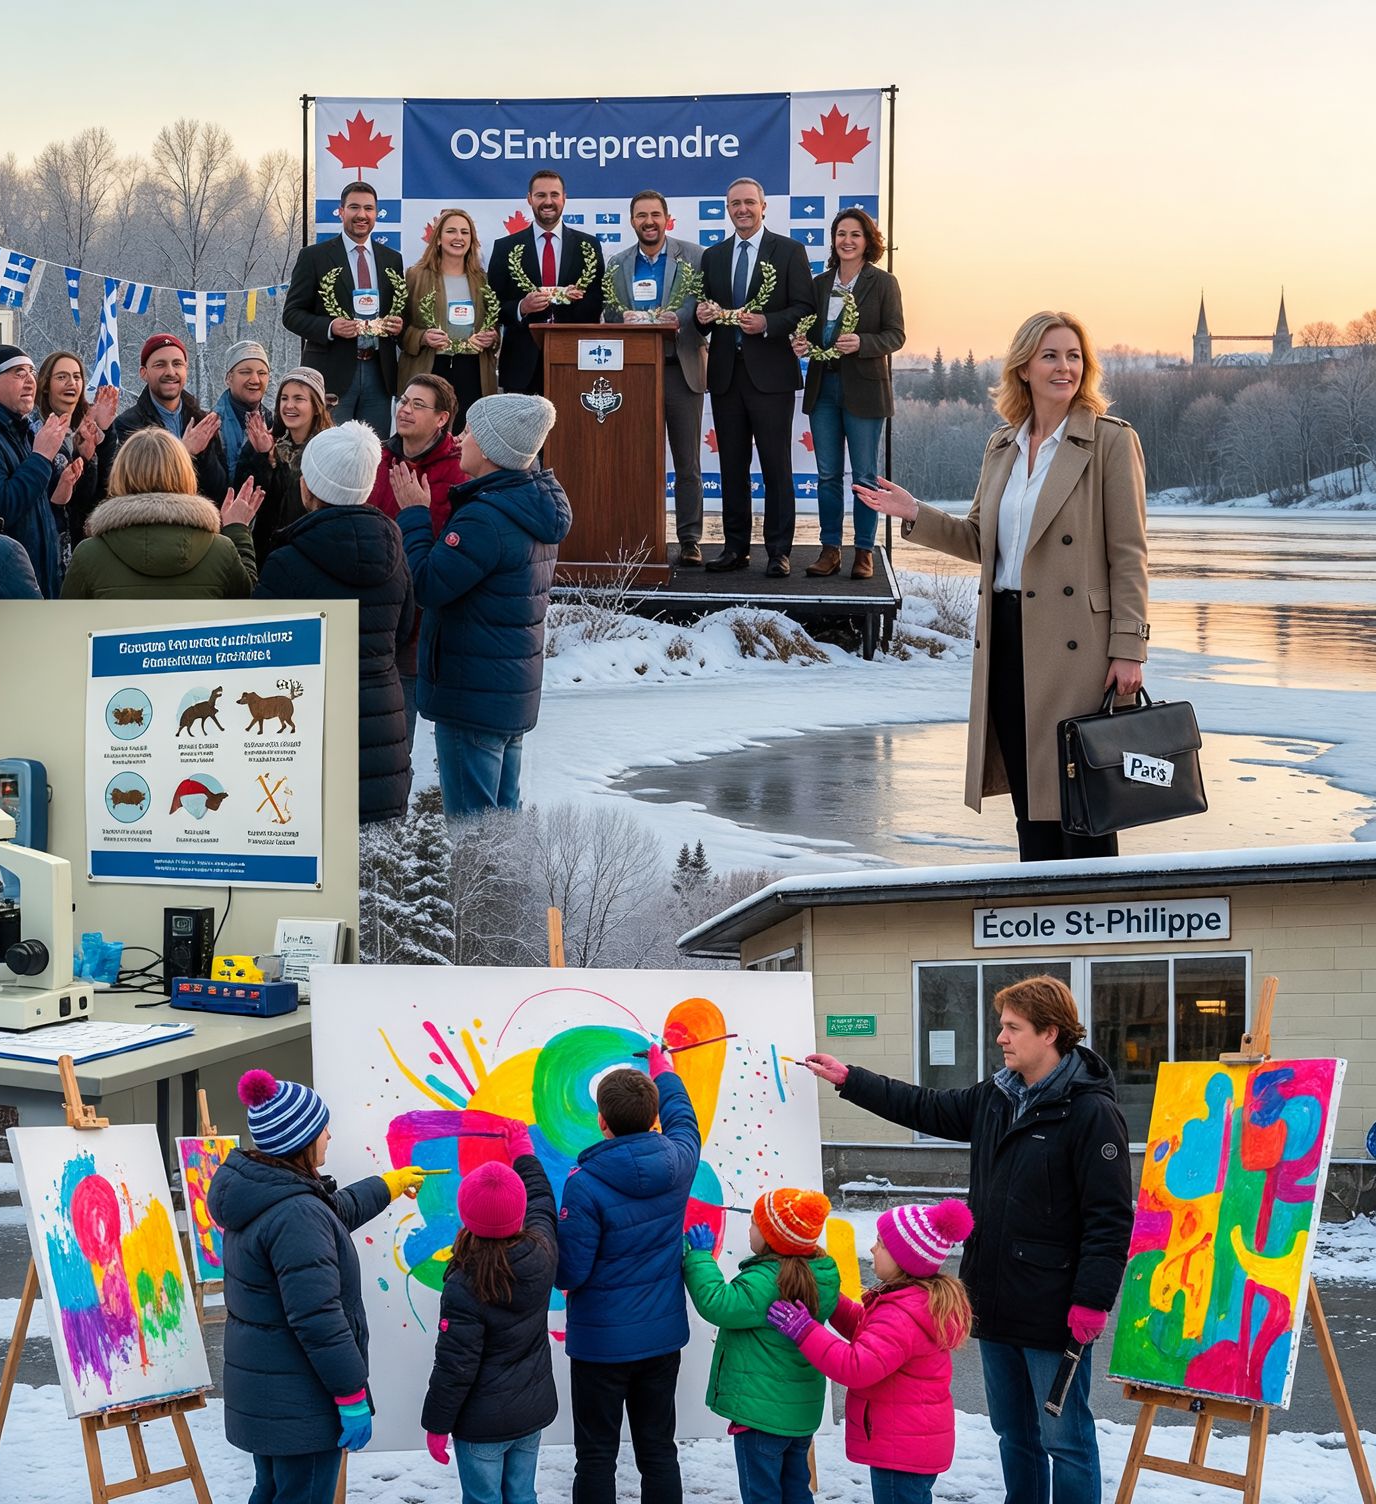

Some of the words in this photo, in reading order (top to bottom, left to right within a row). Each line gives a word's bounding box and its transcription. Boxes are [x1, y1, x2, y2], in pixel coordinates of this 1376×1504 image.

[450, 125, 740, 167] OSEntreprendre
[982, 908, 1056, 939] École
[1065, 907, 1221, 938] St-Philippe
